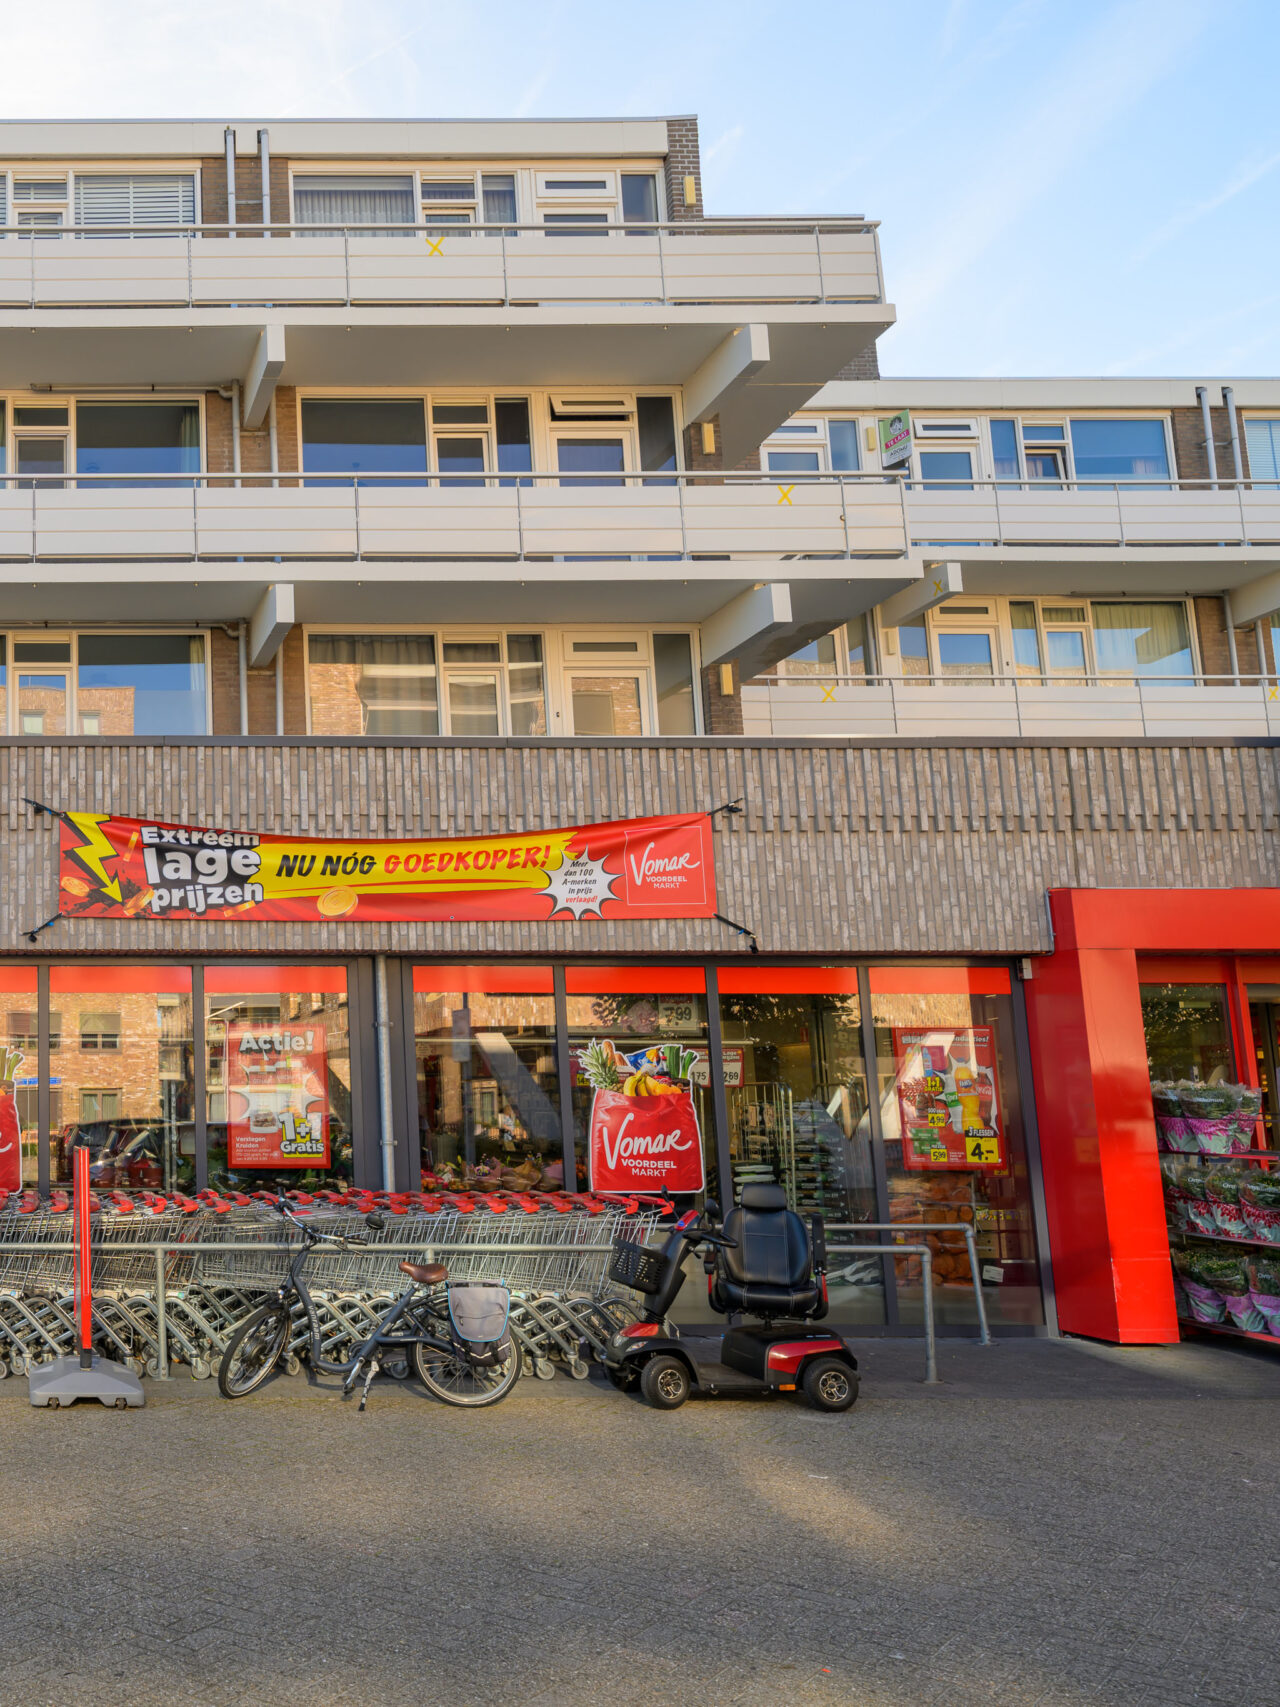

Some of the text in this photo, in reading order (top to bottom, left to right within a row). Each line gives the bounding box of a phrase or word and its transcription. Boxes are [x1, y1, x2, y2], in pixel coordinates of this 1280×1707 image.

[143, 847, 261, 885] lage
[276, 845, 551, 878] NU NÓG GOEDKOPER!
[630, 841, 701, 886] Vomar
[564, 869, 594, 877] dan 100
[645, 875, 688, 883] VOORDEEL
[562, 878, 597, 886] A-merken
[151, 882, 263, 913] prijzen
[576, 887, 593, 896] prijs
[565, 895, 598, 904] verlaagd!
[238, 1030, 315, 1053] Actie!
[926, 1076, 940, 1086] 1+1
[278, 1111, 322, 1142] 1+1
[602, 1112, 692, 1170] Vomar
[280, 1141, 325, 1154] Gratis
[621, 1158, 677, 1169] VOORDEEL
[631, 1168, 668, 1177] MARKT
